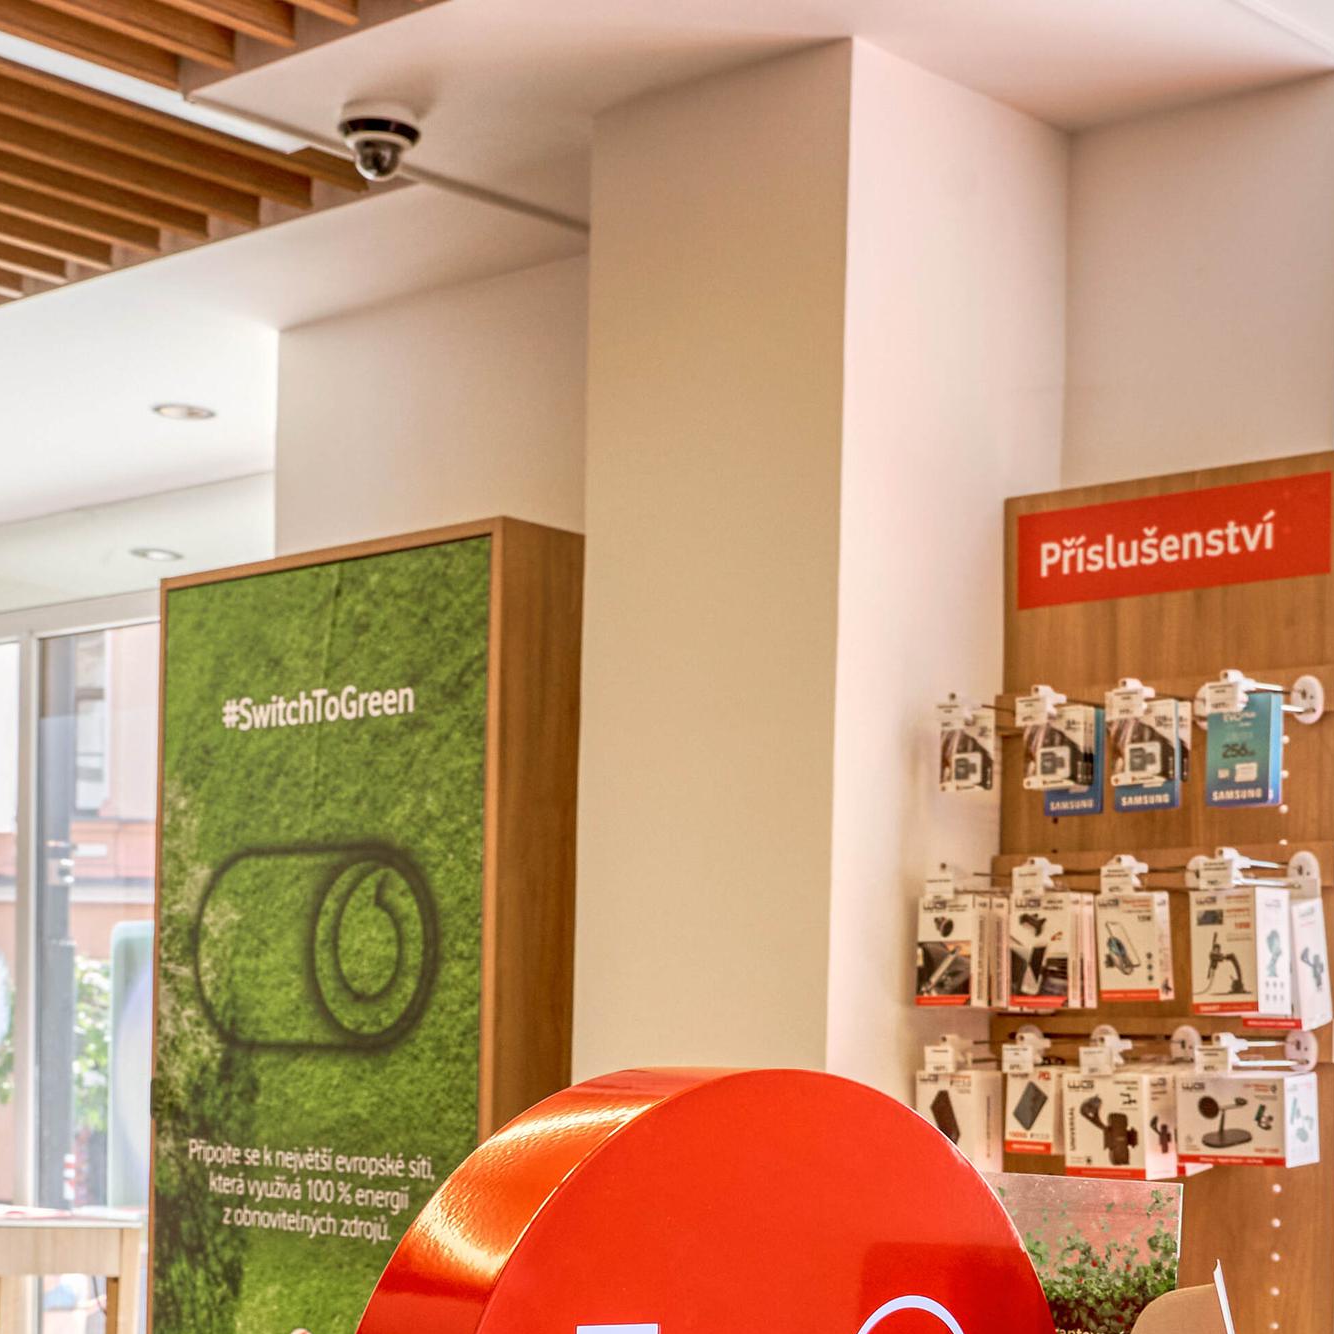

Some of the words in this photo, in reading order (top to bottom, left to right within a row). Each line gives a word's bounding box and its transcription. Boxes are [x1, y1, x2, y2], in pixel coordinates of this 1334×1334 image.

[1040, 509, 1275, 578] Příslušenství
[221, 684, 415, 731] #SwitchToGreen
[1049, 798, 1094, 811] SAMSUNG
[1121, 794, 1170, 807] SAMSUNG
[1212, 788, 1263, 801] SAMSUNG
[188, 1139, 241, 1169] Připojte
[243, 1149, 260, 1165] se
[264, 1146, 272, 1166] k
[275, 1147, 334, 1173] největší
[335, 1153, 405, 1179] evropské
[409, 1154, 435, 1181] síti,
[209, 1172, 244, 1195] která
[247, 1176, 301, 1202] využívá
[307, 1179, 334, 1203] 100
[337, 1184, 352, 1205] %
[355, 1186, 409, 1215] energií
[223, 1209, 231, 1225] z
[234, 1206, 336, 1239] obnovitelných
[340, 1215, 392, 1244] zdrojů.
